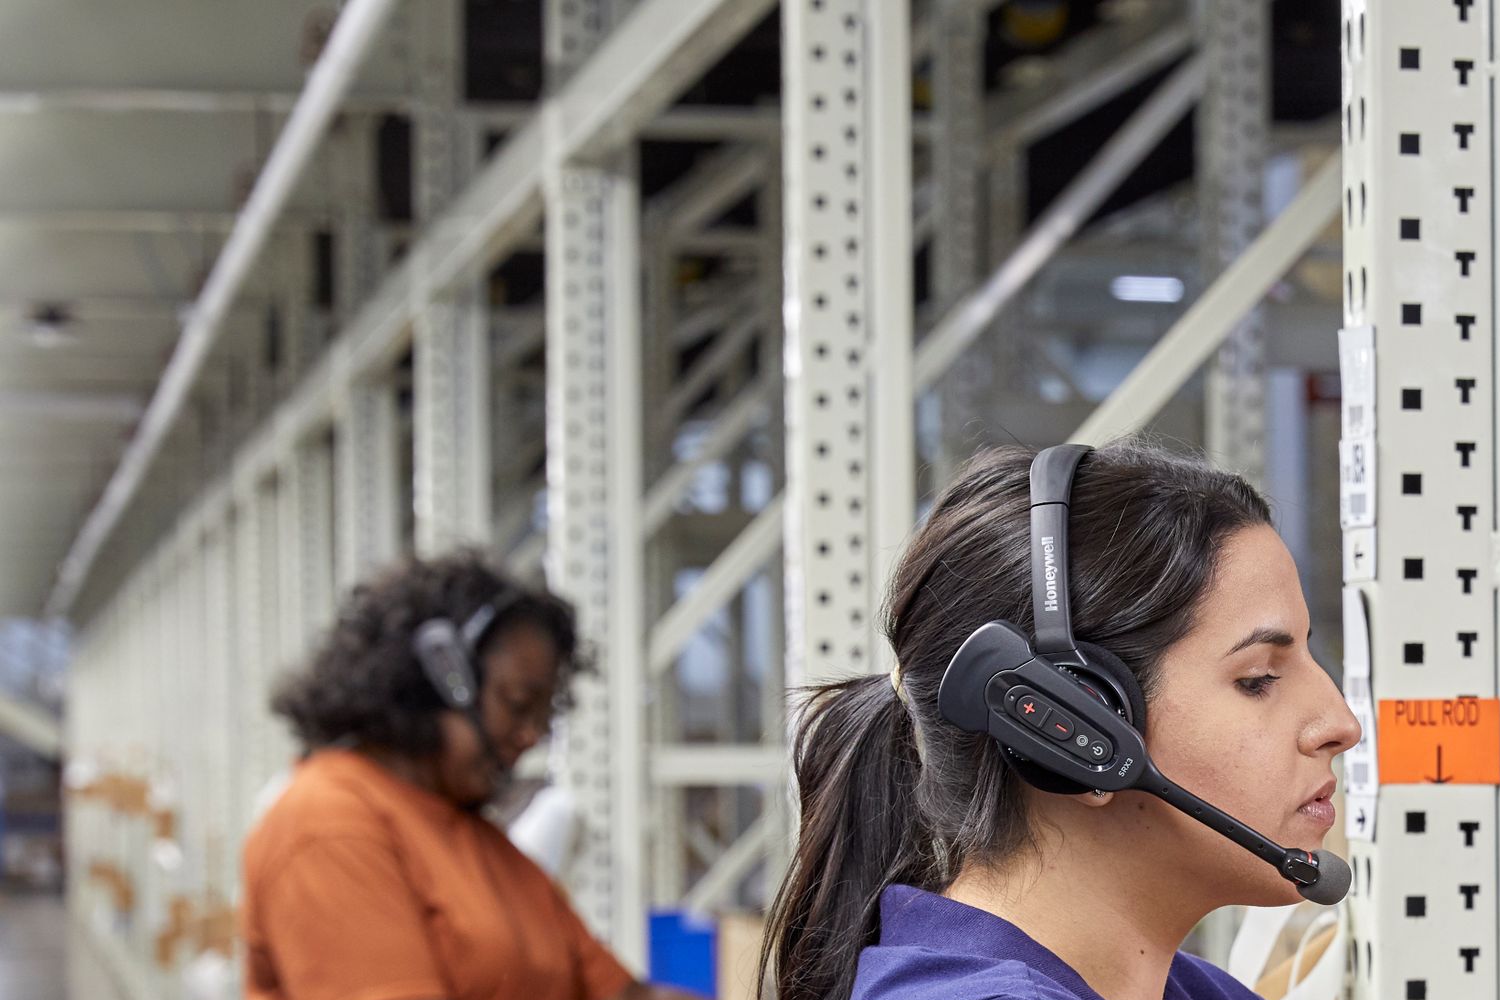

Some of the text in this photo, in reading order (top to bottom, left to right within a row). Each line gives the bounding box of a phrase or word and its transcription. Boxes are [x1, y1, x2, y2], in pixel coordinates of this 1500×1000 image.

[1041, 536, 1058, 612] Honeywell
[1394, 700, 1480, 727] PULL ROD
[1118, 757, 1134, 777] SRX3
